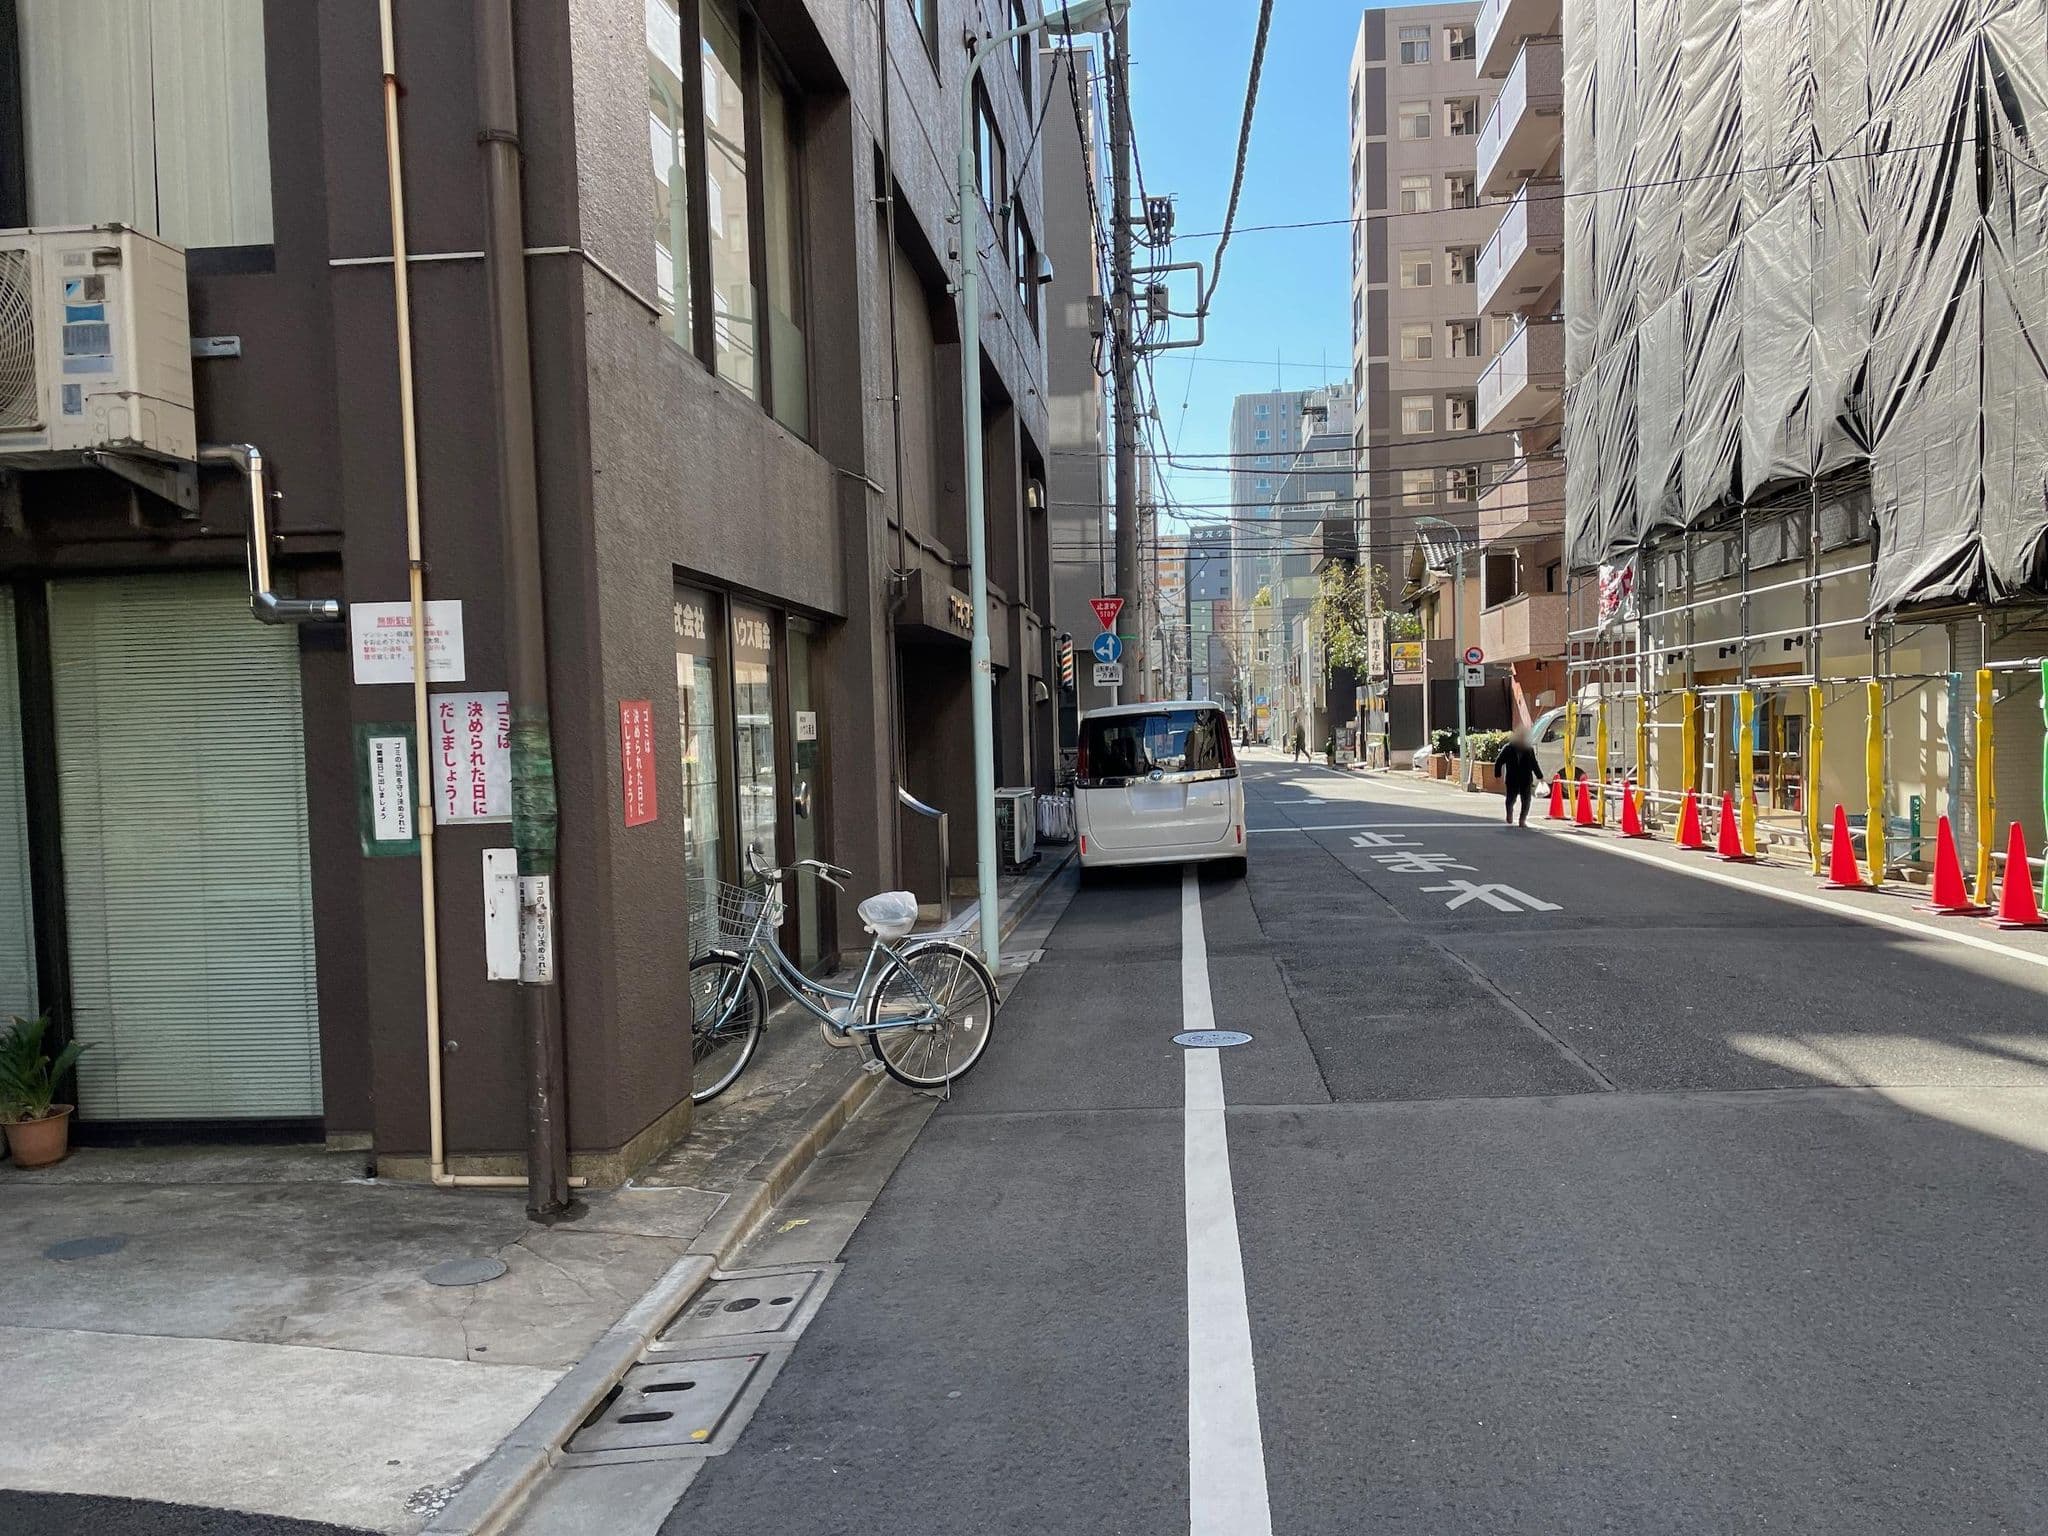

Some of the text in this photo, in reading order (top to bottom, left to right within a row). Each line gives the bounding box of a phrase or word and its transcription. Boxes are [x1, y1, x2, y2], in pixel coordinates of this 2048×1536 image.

[1096, 602, 1117, 610] 止まれ
[467, 701, 488, 815] 決められた日に
[633, 708, 644, 816] 決められた日に
[1349, 831, 1563, 912] 止まれ
